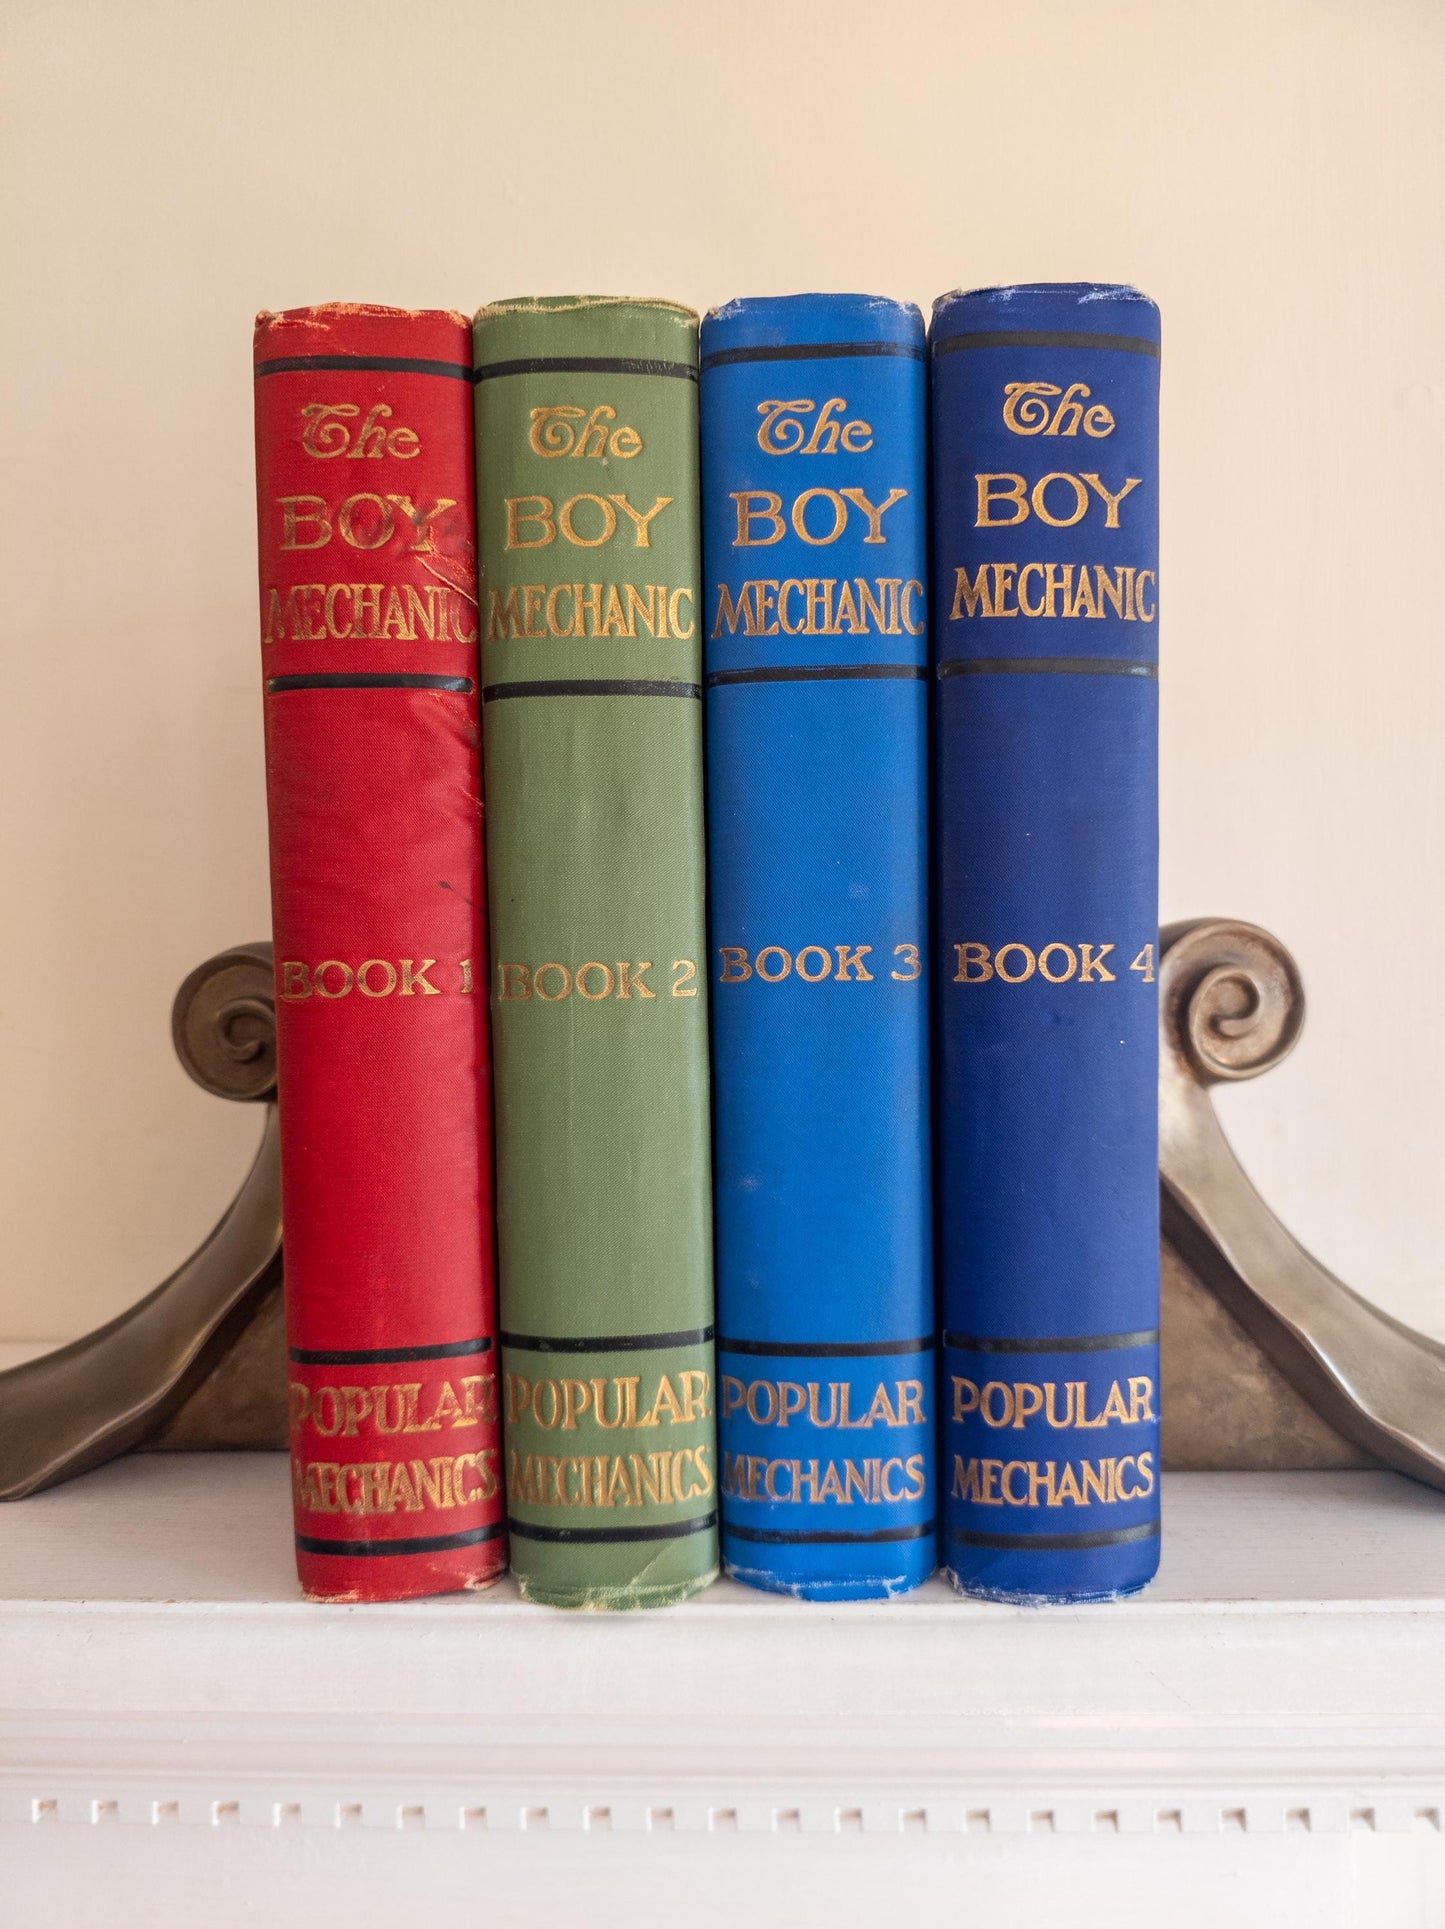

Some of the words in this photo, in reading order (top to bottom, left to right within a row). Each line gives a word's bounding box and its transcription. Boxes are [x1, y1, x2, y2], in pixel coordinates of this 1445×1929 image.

[302, 404, 421, 459] The
[530, 405, 643, 459] The
[757, 397, 874, 455] The
[1003, 382, 1115, 438] The
[277, 492, 457, 552] BOY
[504, 493, 674, 551] BOY
[730, 487, 908, 546] BOY
[974, 472, 1142, 528] BOY
[263, 583, 478, 644] MECHANIC
[487, 583, 695, 642] MECHANIC
[711, 578, 924, 638] MECHANIC
[949, 563, 1156, 622] MECHANIC
[280, 958, 440, 999] BOOK
[459, 958, 475, 995] 1
[498, 961, 656, 1000] BOOK
[671, 959, 698, 997] 2
[719, 945, 873, 982] BOOK
[891, 943, 922, 981] 3
[953, 942, 1116, 983] BOOK
[1130, 943, 1155, 983] 4
[289, 1375, 496, 1437] POPULAR
[507, 1370, 712, 1430] POPULAR
[722, 1374, 927, 1428] POPULAR
[951, 1376, 1154, 1428] POPULAR
[295, 1448, 500, 1514] MECHANICS
[509, 1445, 713, 1507] MECHANICS
[722, 1453, 926, 1505] MECHANICS
[951, 1451, 1154, 1507] MECHANICS
